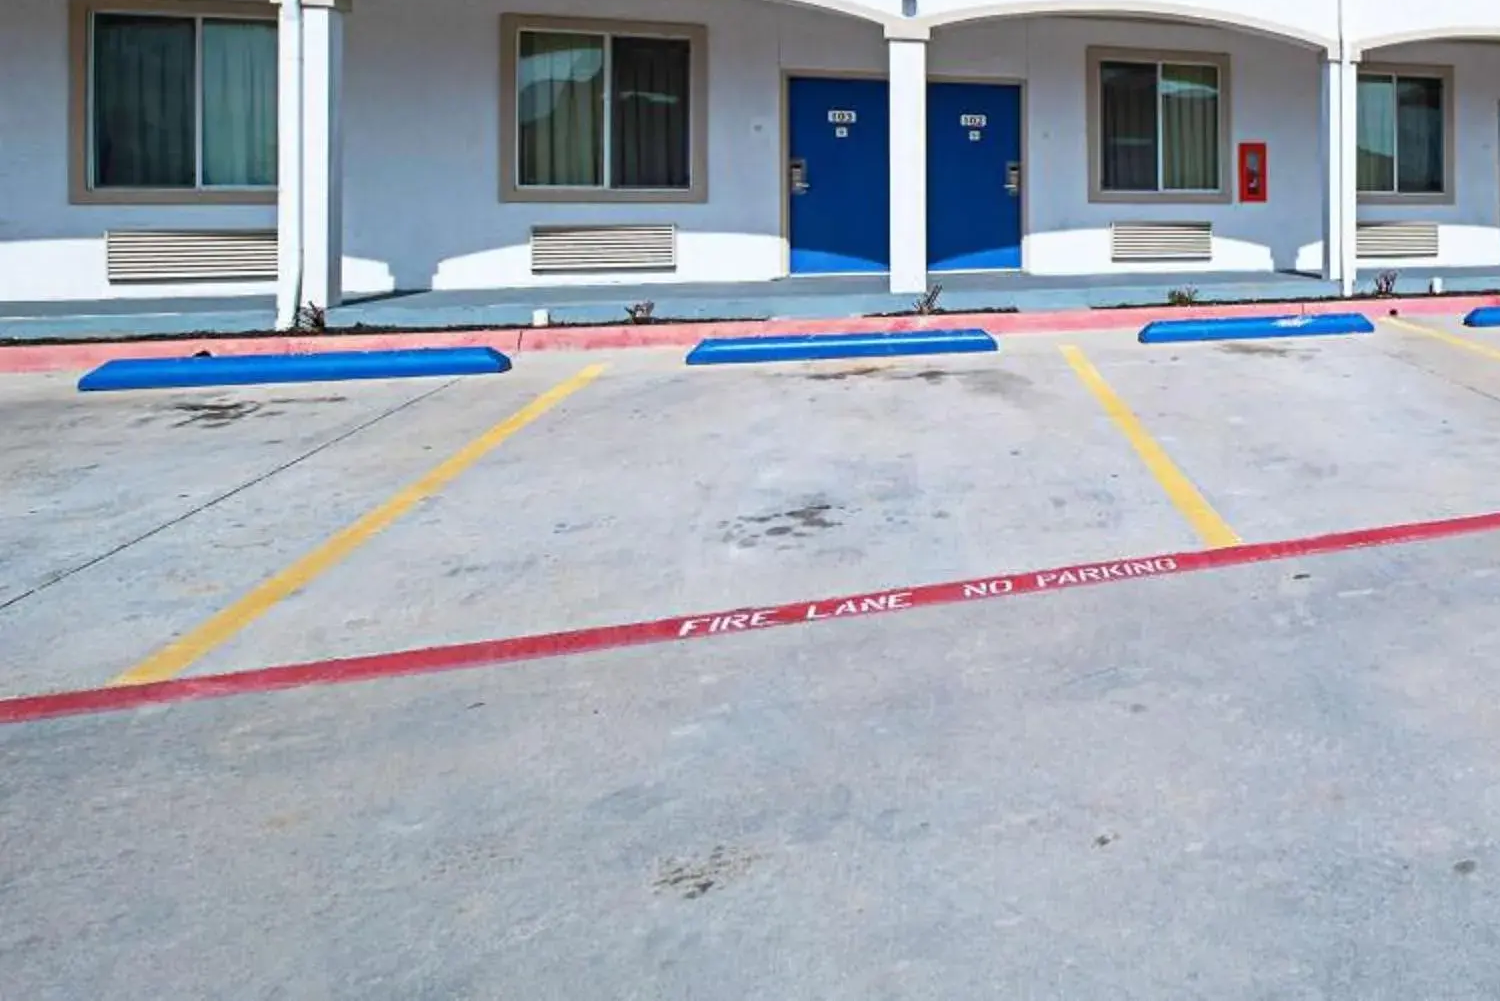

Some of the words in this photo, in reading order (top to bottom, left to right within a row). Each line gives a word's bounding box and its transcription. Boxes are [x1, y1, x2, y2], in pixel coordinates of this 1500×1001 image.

[679, 610, 779, 637] FIRE
[806, 592, 913, 619] LANE
[963, 579, 1013, 598] NO
[1035, 558, 1178, 588] PARKING
